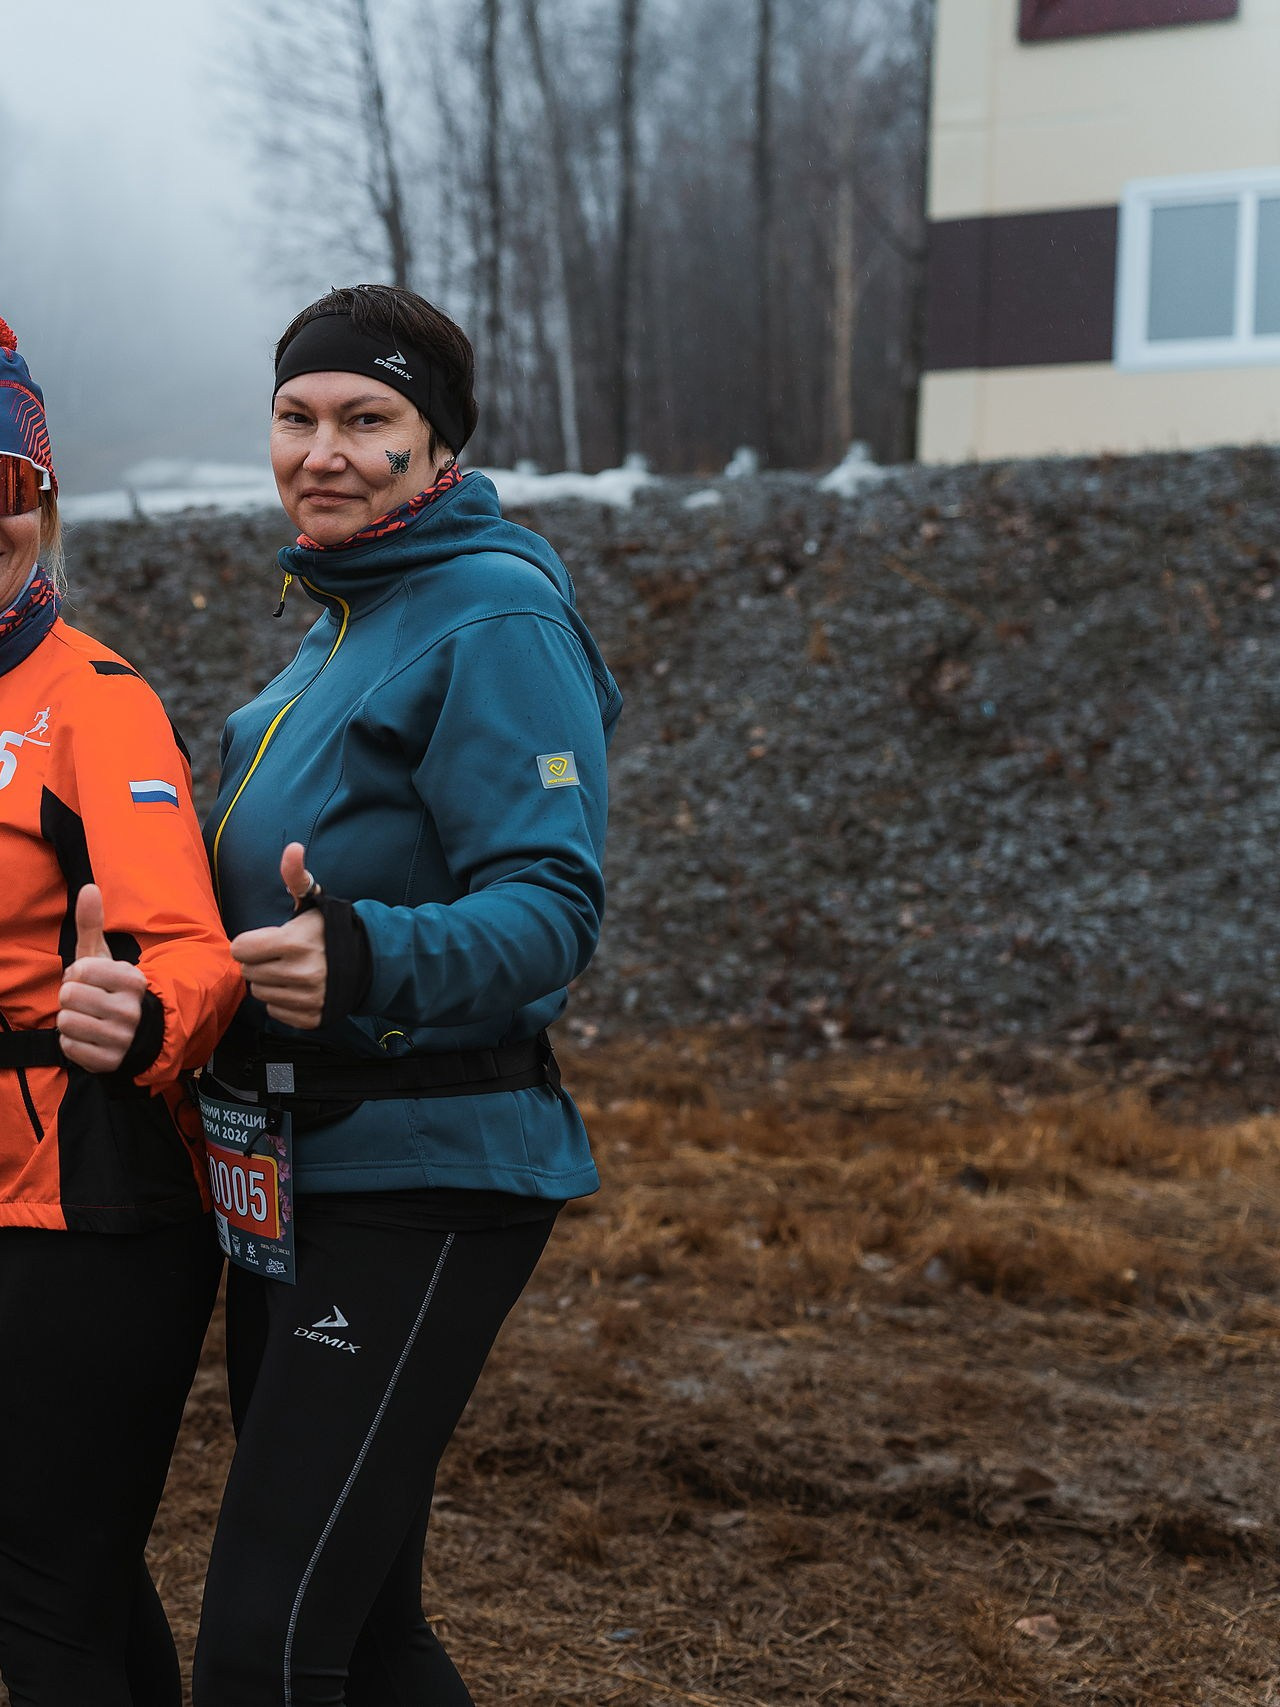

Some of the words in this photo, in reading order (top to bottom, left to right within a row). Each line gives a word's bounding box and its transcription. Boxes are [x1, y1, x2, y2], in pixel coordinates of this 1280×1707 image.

[373, 357, 414, 381] DEMIX
[221, 1126, 249, 1144] 2026
[208, 1154, 267, 1222] 0005
[293, 1327, 362, 1354] DEMIX
